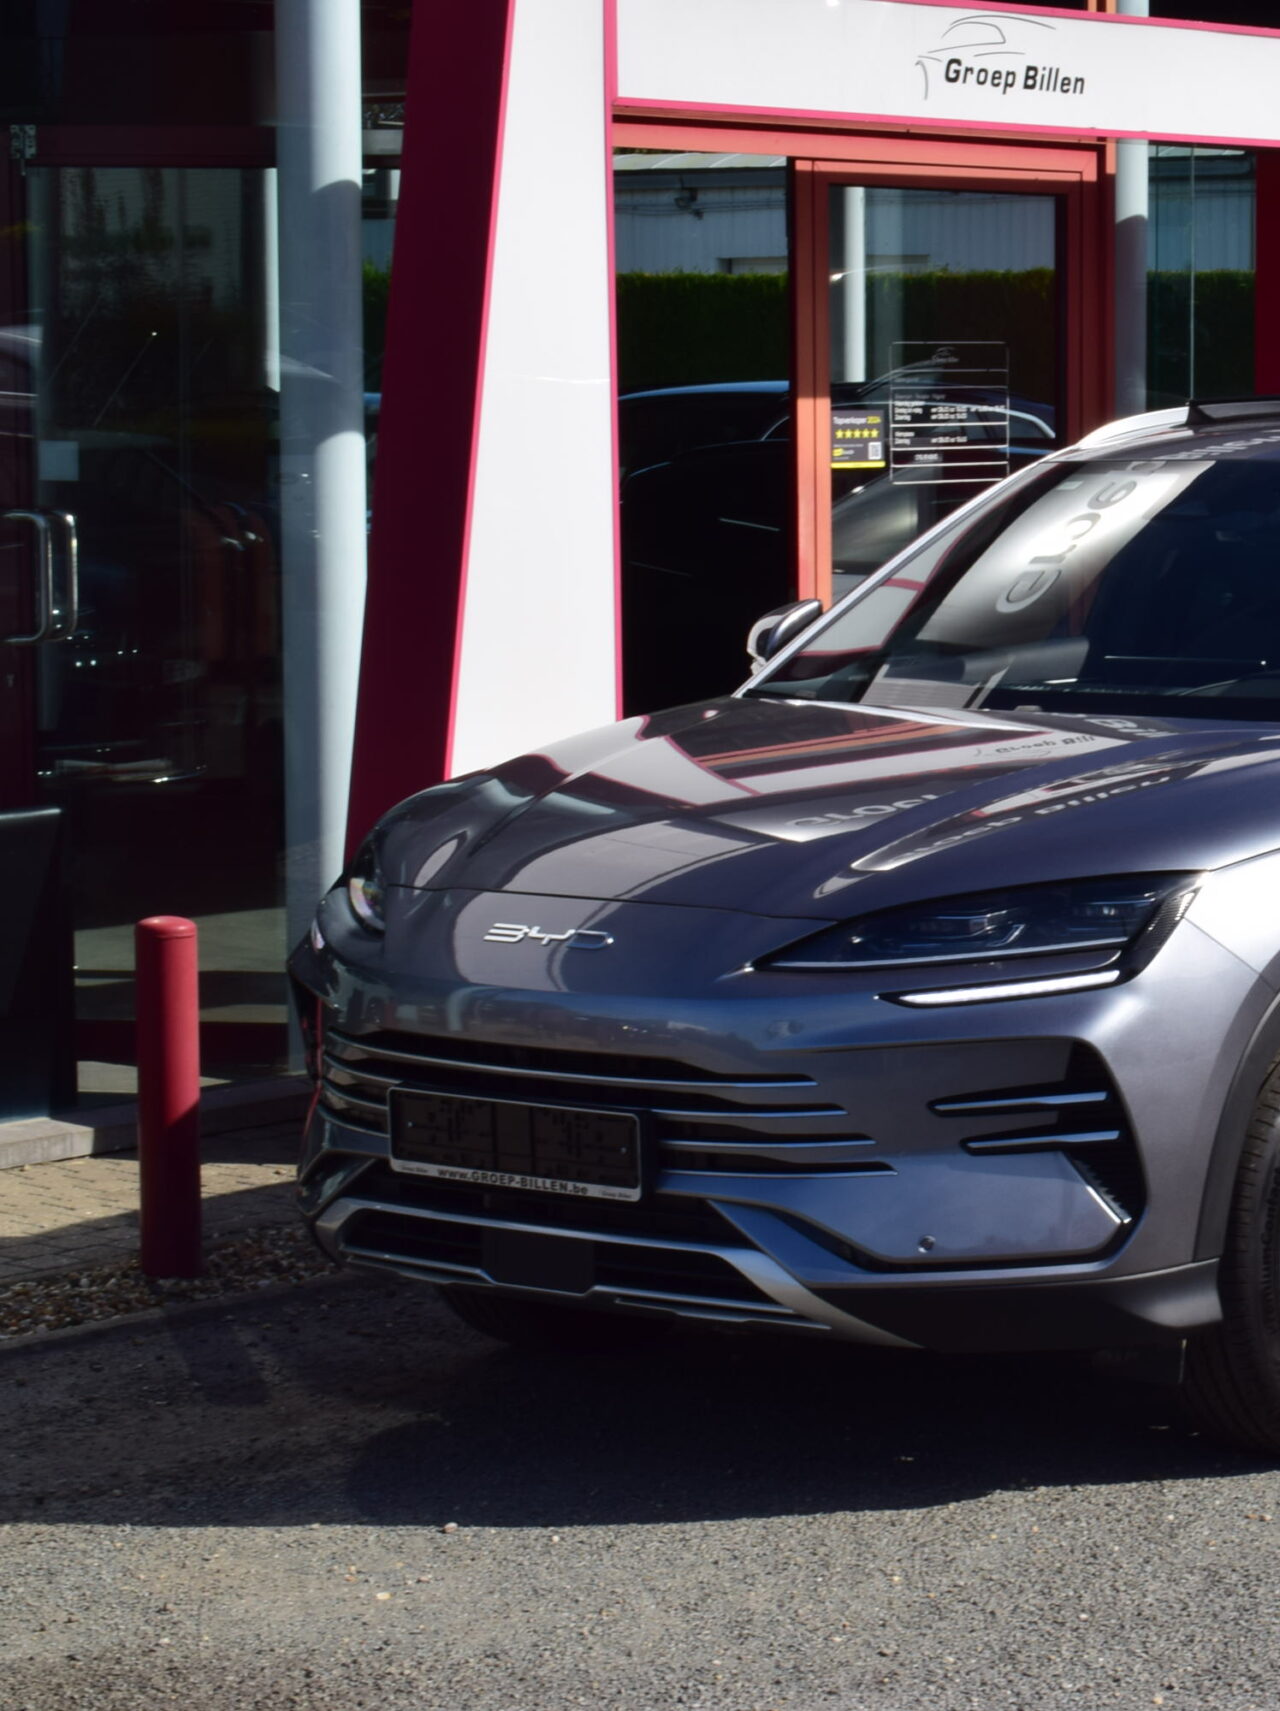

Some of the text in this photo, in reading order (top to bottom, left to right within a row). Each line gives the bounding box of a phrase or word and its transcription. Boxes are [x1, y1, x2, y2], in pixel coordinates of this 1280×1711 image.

[944, 58, 1085, 95] Groep Billen
[483, 922, 614, 949] BYD
[437, 1167, 589, 1196] www.GROEP-BILLEN.be
